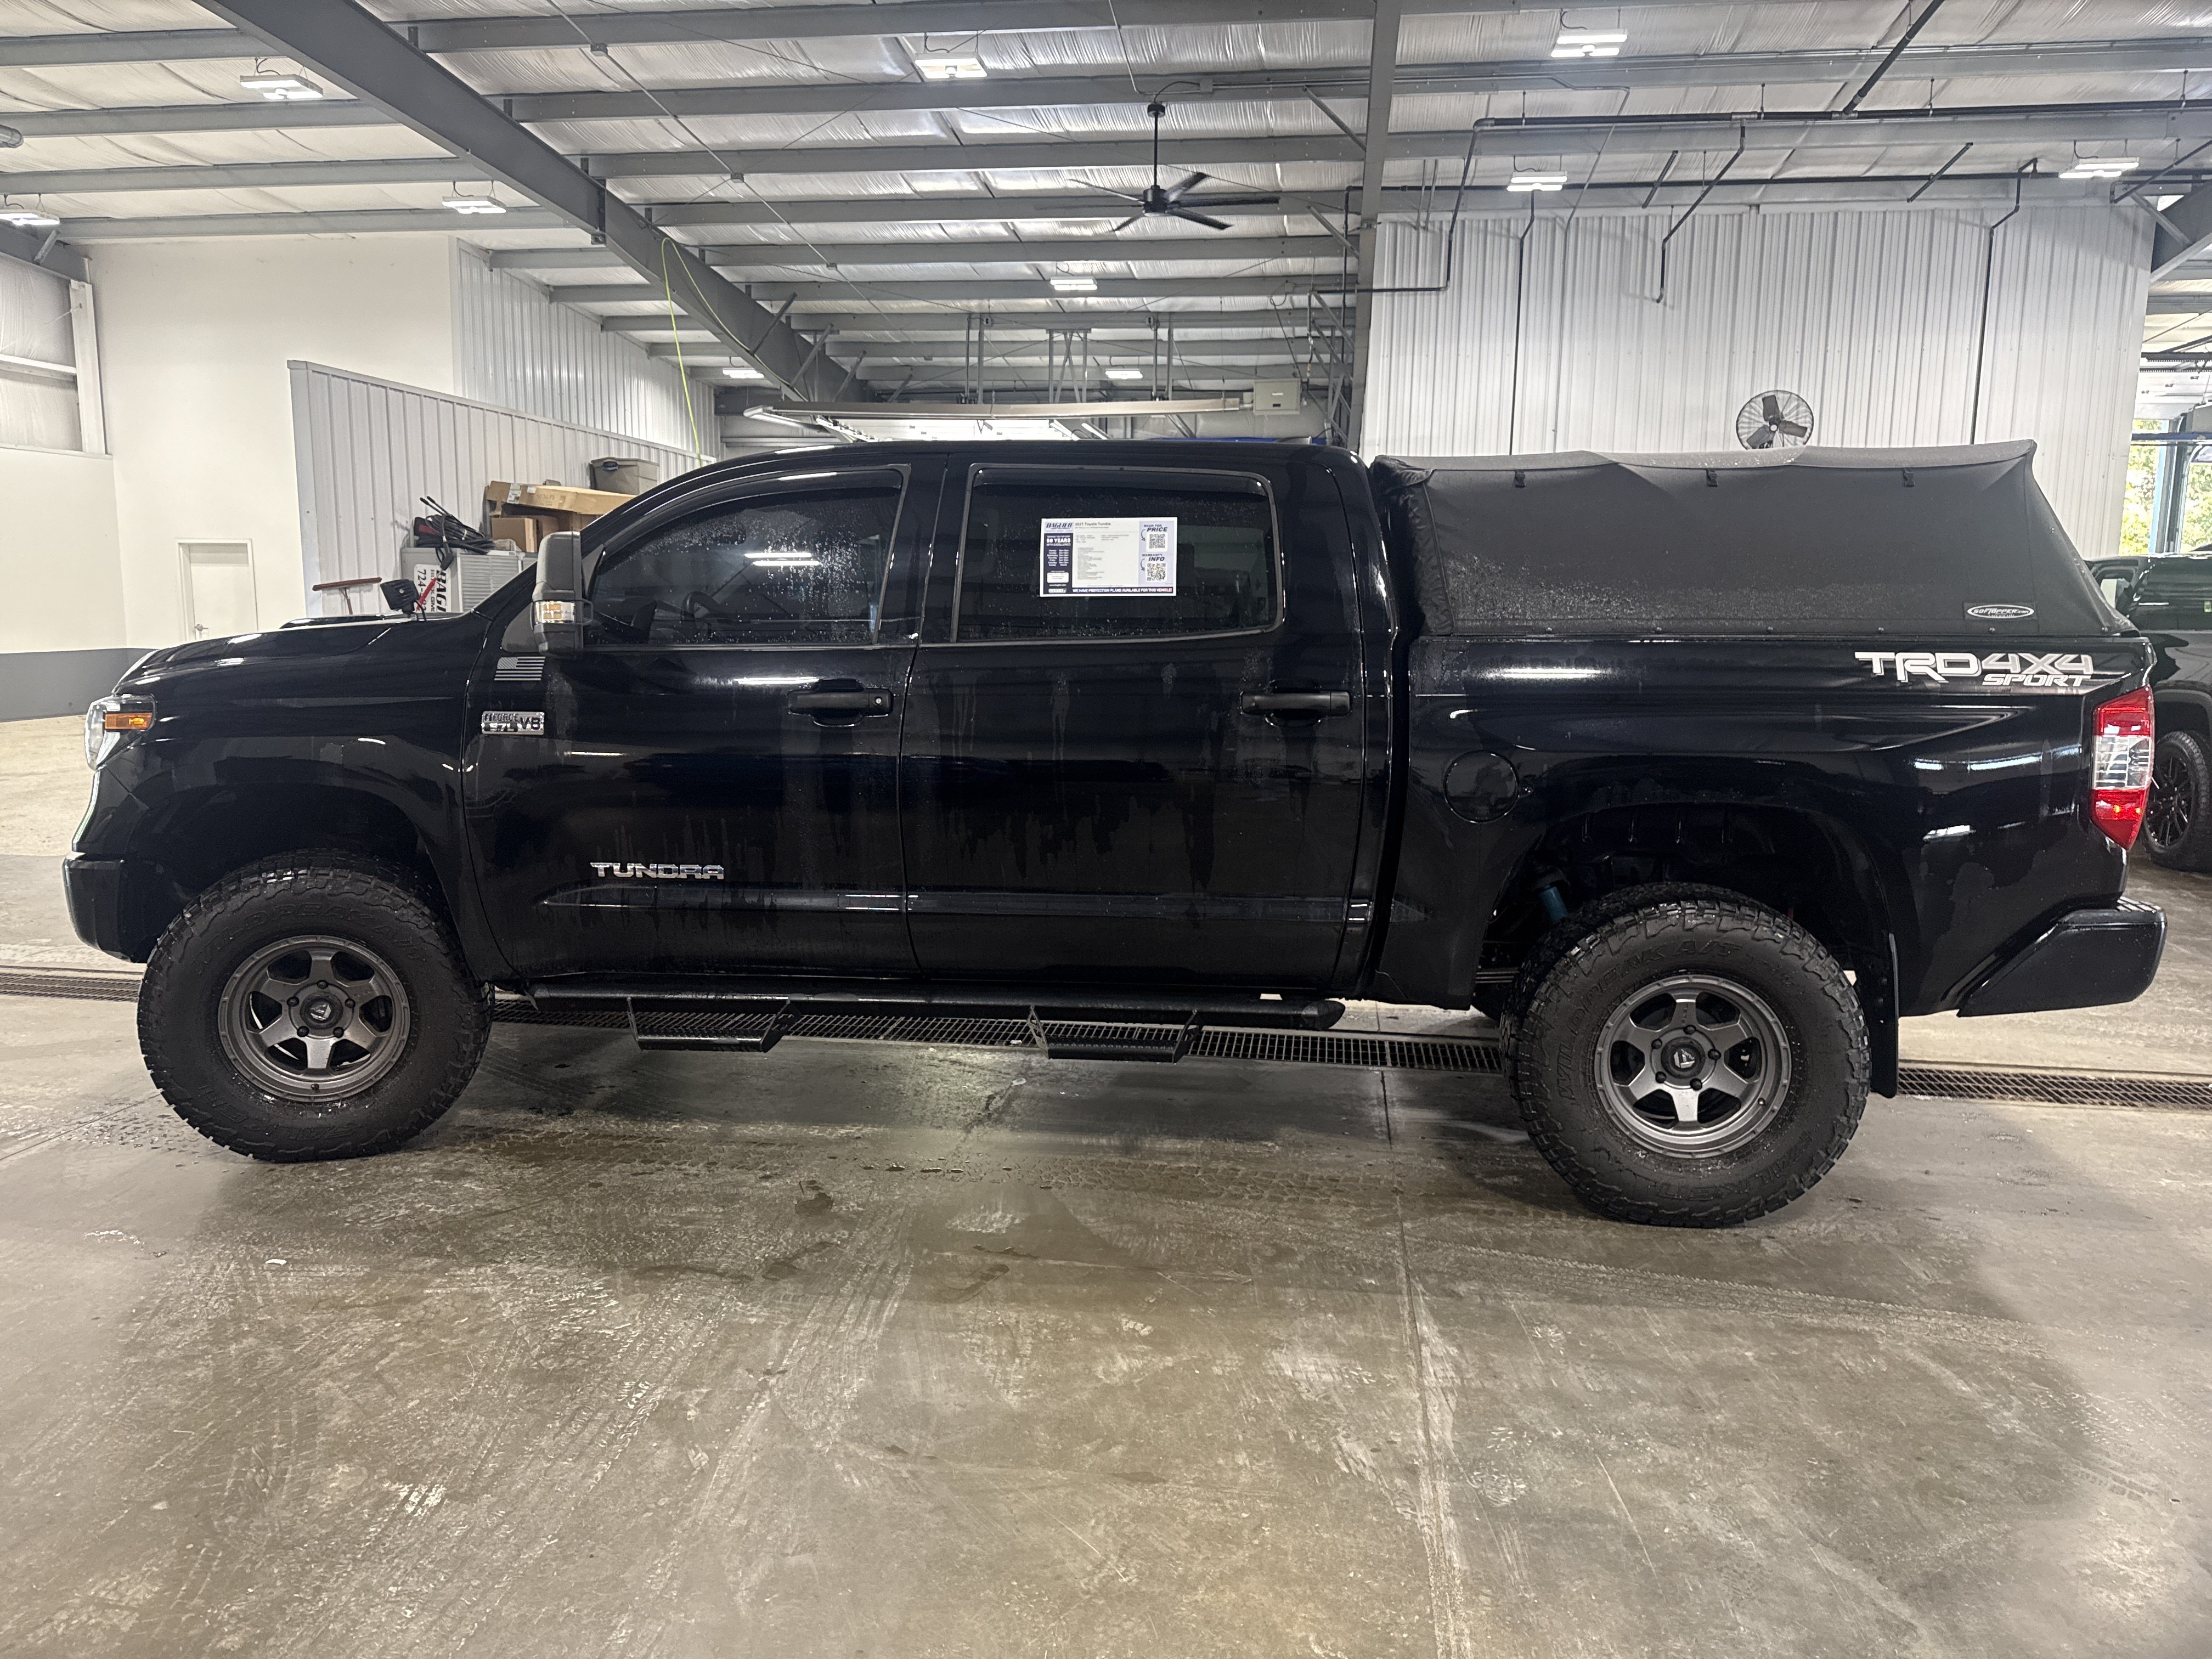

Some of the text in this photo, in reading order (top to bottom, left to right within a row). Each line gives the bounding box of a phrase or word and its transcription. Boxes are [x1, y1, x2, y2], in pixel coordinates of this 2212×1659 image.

[1854, 651, 2094, 684] TRD 4X4
[1982, 673, 2094, 687] SPORT
[520, 716, 541, 730] V8
[589, 862, 724, 879] TUNDRA
[1557, 943, 1673, 1099] WILDPEAK
